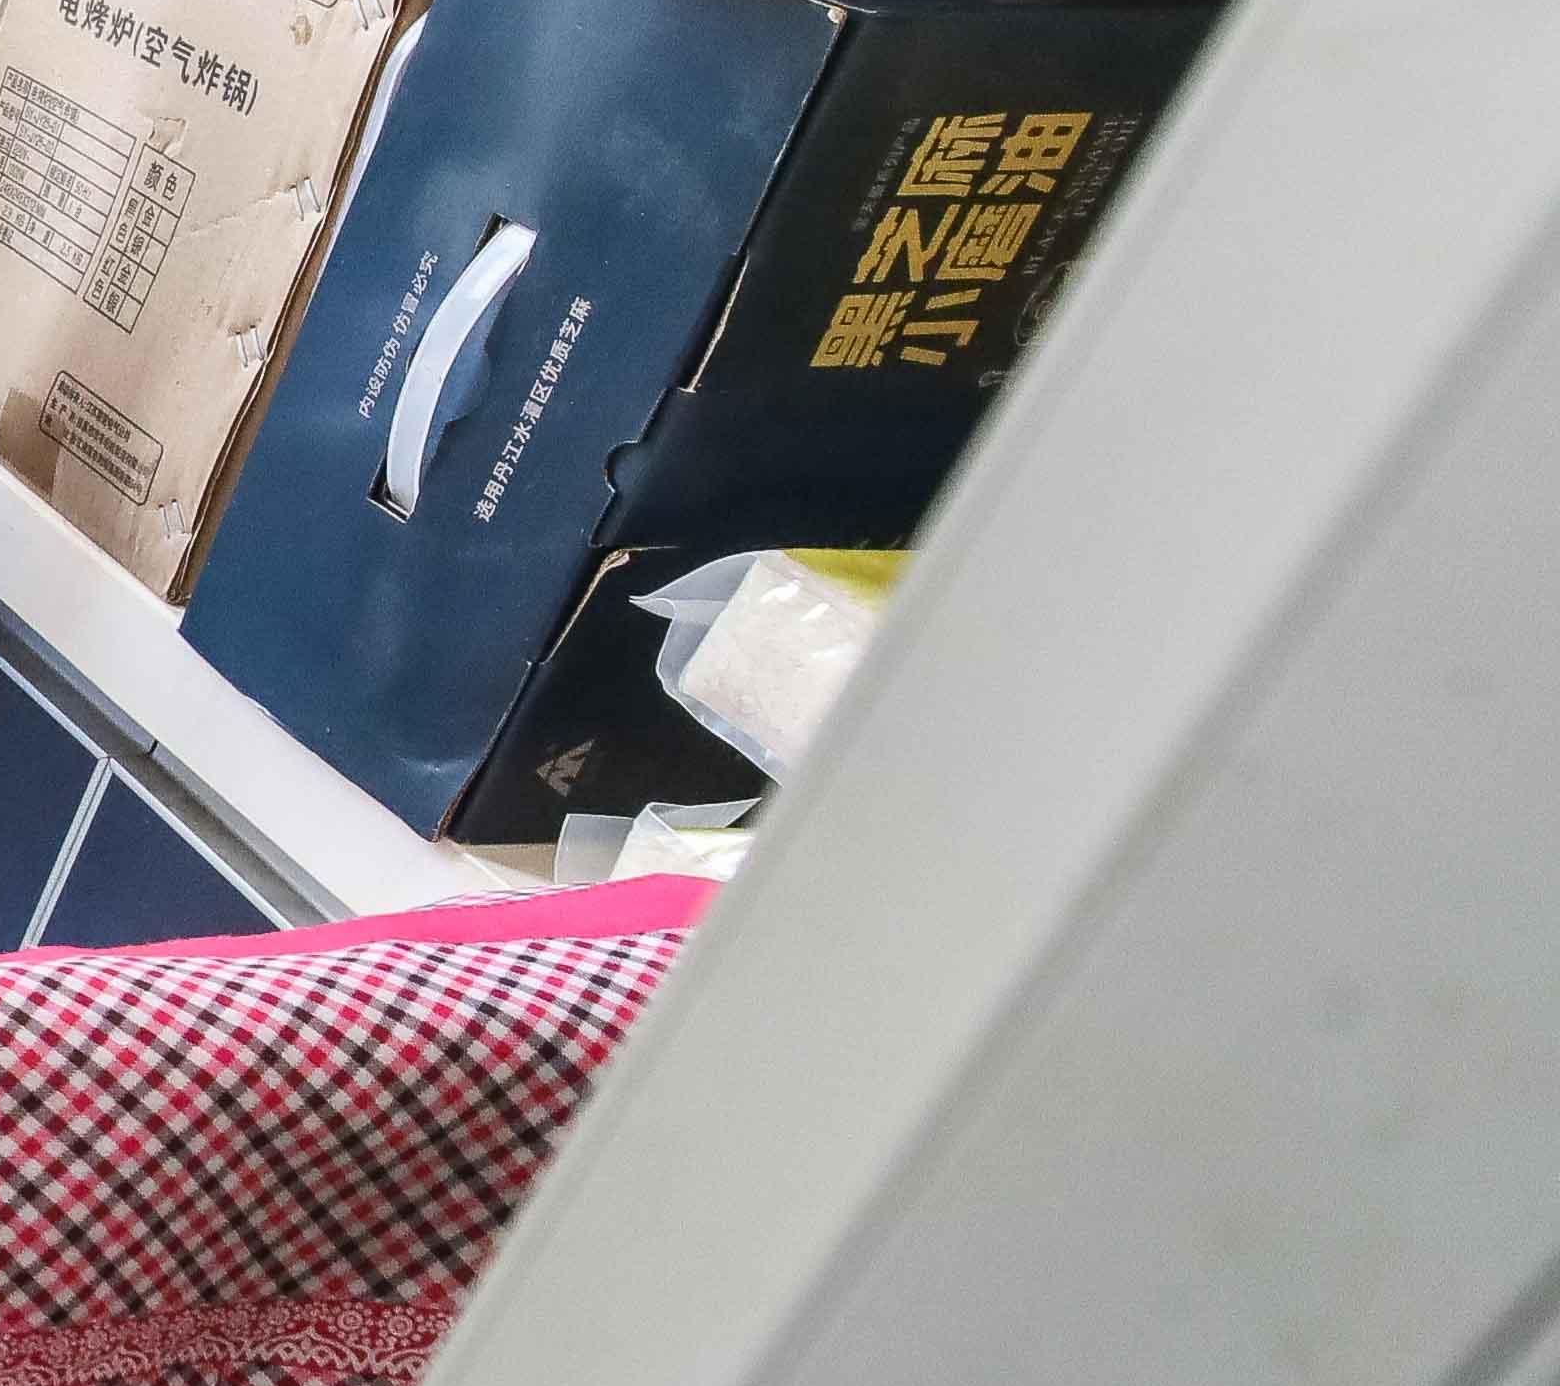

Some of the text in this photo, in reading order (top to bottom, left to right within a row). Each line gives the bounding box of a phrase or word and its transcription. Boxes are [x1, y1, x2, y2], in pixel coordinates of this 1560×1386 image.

[144, 160, 177, 201] 颜色
[808, 112, 1008, 369] 黑芝麻
[900, 111, 1095, 367] 小磨油
[358, 249, 439, 420] 内设防伪 仿冒必究
[472, 295, 594, 524] 选用丹江水灌区优质芝麻
